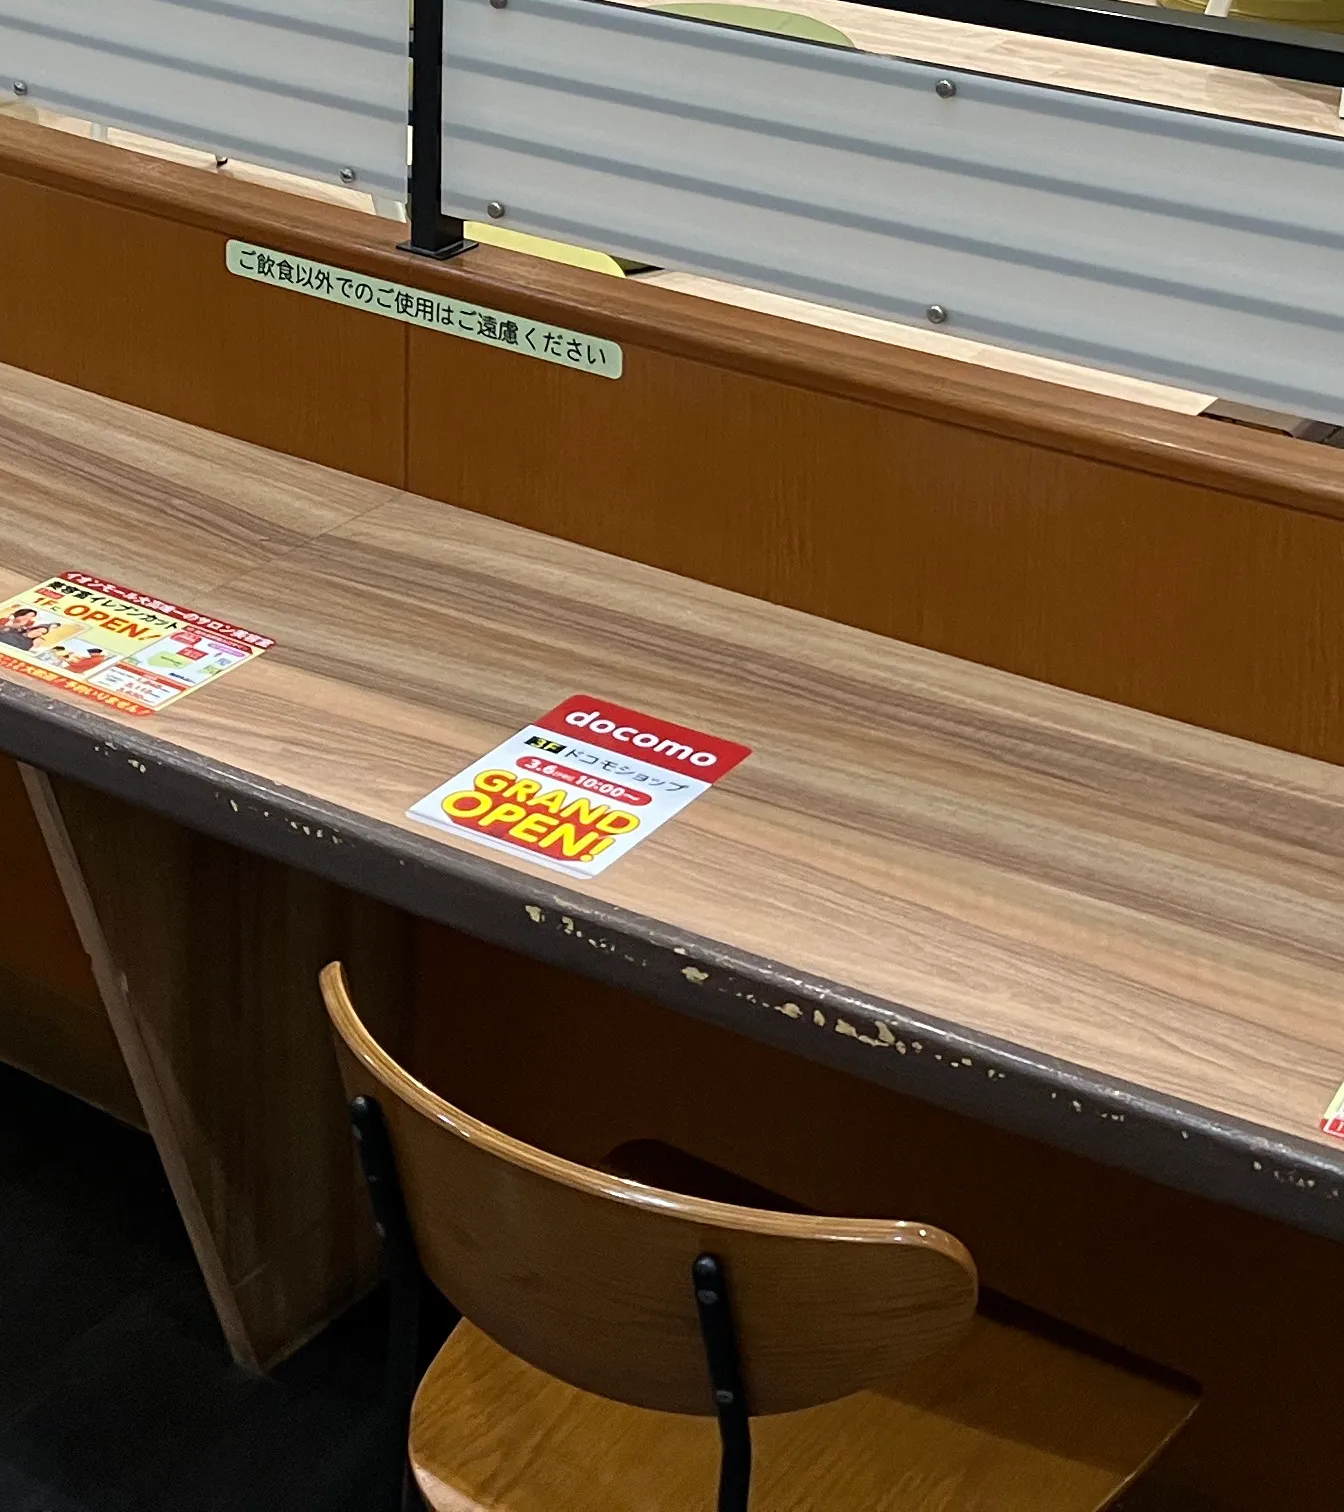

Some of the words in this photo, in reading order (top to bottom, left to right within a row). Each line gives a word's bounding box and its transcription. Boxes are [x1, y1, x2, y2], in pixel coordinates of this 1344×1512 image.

[239, 249, 607, 366] ご飲食以外でのご使用はご遠慮ください
[532, 738, 561, 753] 3F
[563, 748, 690, 792] ドコモショップ
[564, 710, 718, 768] docomo
[441, 790, 616, 863] OPEN!
[474, 769, 641, 835] GRAND
